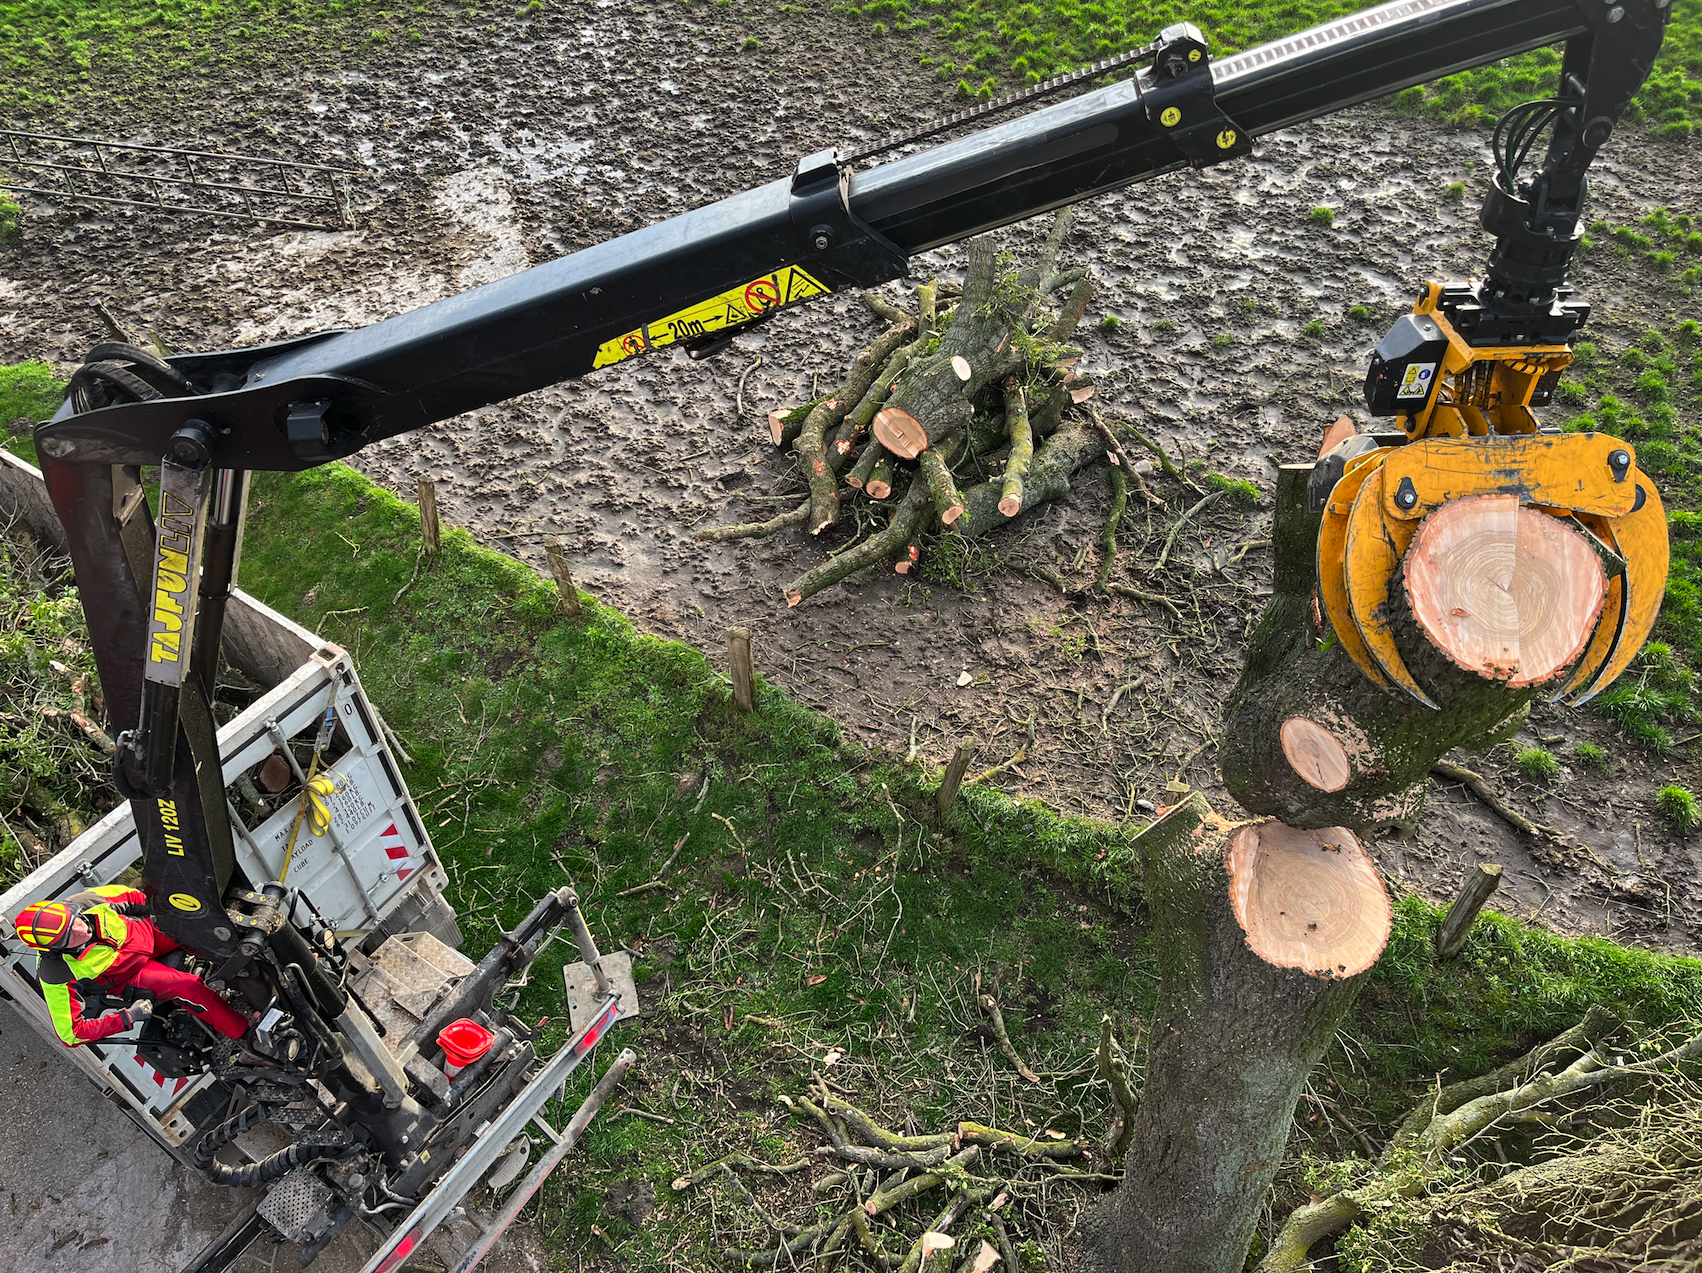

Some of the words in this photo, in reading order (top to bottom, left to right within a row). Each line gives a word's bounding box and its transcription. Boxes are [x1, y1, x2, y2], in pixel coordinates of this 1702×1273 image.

[668, 319, 706, 340] 20m
[157, 798, 180, 832] 120Z
[164, 834, 185, 857] LIV
[289, 838, 314, 863] AYLOAD
[293, 857, 310, 873] CUBE
